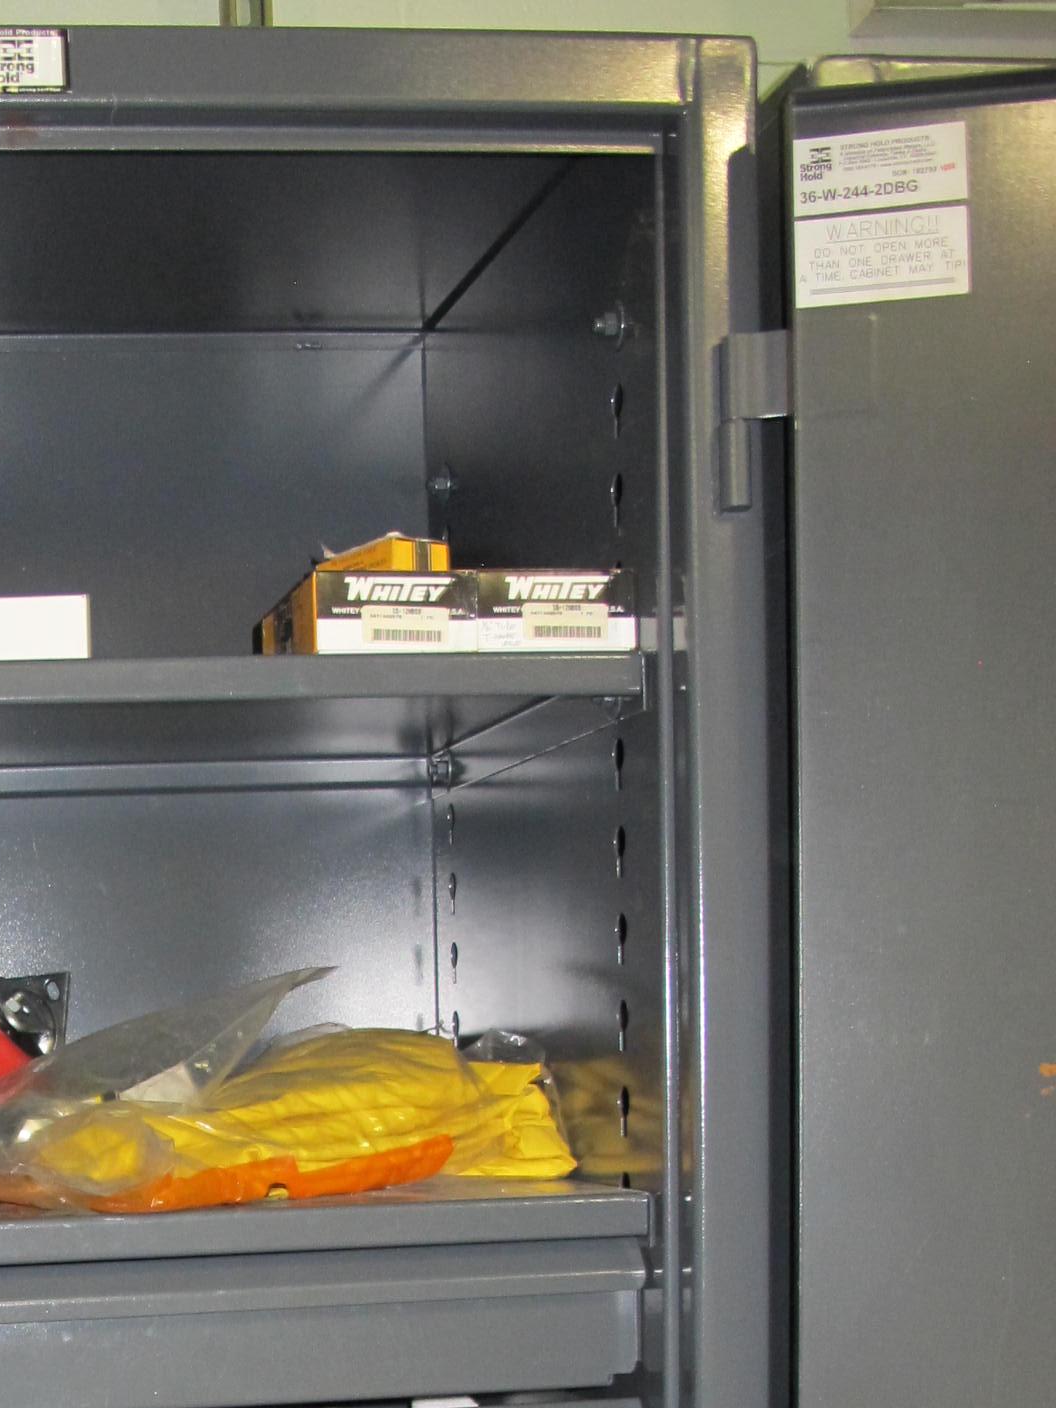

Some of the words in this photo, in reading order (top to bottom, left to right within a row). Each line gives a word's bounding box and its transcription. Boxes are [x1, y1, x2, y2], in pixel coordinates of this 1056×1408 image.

[800, 162, 832, 174] Strong
[800, 171, 824, 182] Hold
[800, 180, 919, 204] 36-W-244-2DBG
[826, 215, 939, 240] WARNING!!
[814, 247, 831, 259] DO
[840, 245, 865, 256] NOT
[874, 241, 906, 253] OPEN
[915, 237, 949, 249] MORE
[809, 259, 840, 271] THAN
[848, 256, 872, 268] ONE
[881, 251, 931, 266] DRAWER
[941, 249, 955, 259] AT
[850, 265, 900, 279] CABINET
[909, 263, 934, 275] MAY
[343, 576, 452, 603] WHITEY
[503, 575, 610, 600] WHITEY
[331, 607, 360, 615] WHITEY
[492, 606, 521, 614] WHITEY
